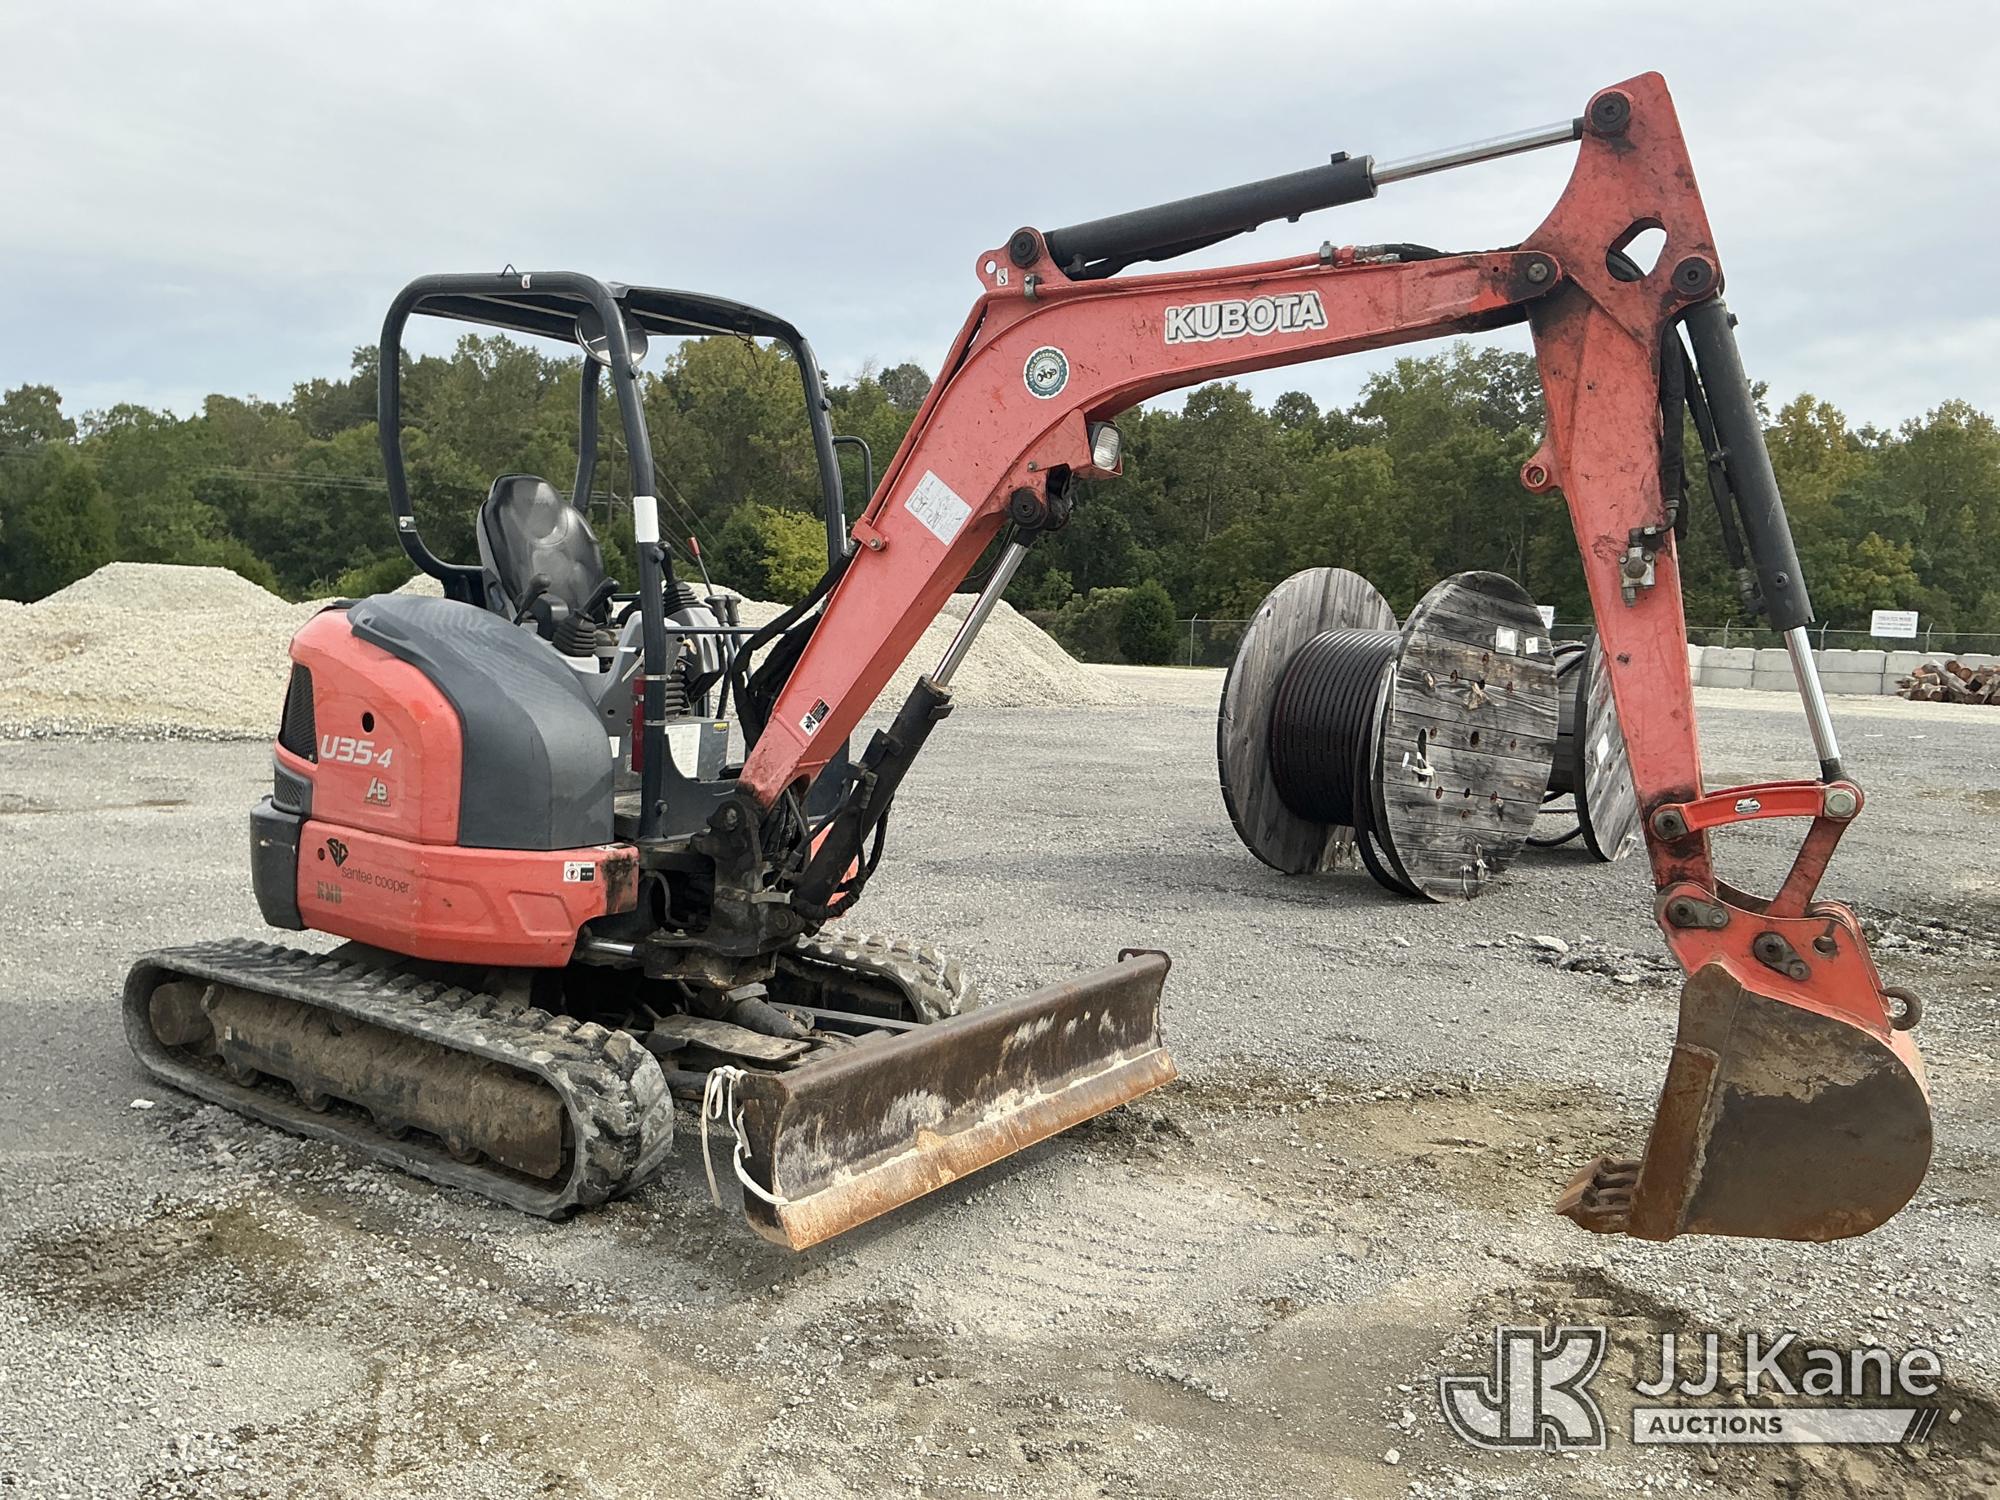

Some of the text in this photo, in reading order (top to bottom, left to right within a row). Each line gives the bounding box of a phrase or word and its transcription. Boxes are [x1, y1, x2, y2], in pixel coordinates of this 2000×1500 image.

[1166, 291, 1327, 343] KUBOTA
[320, 734, 393, 768] U35-4
[341, 865, 410, 894] santee cooper
